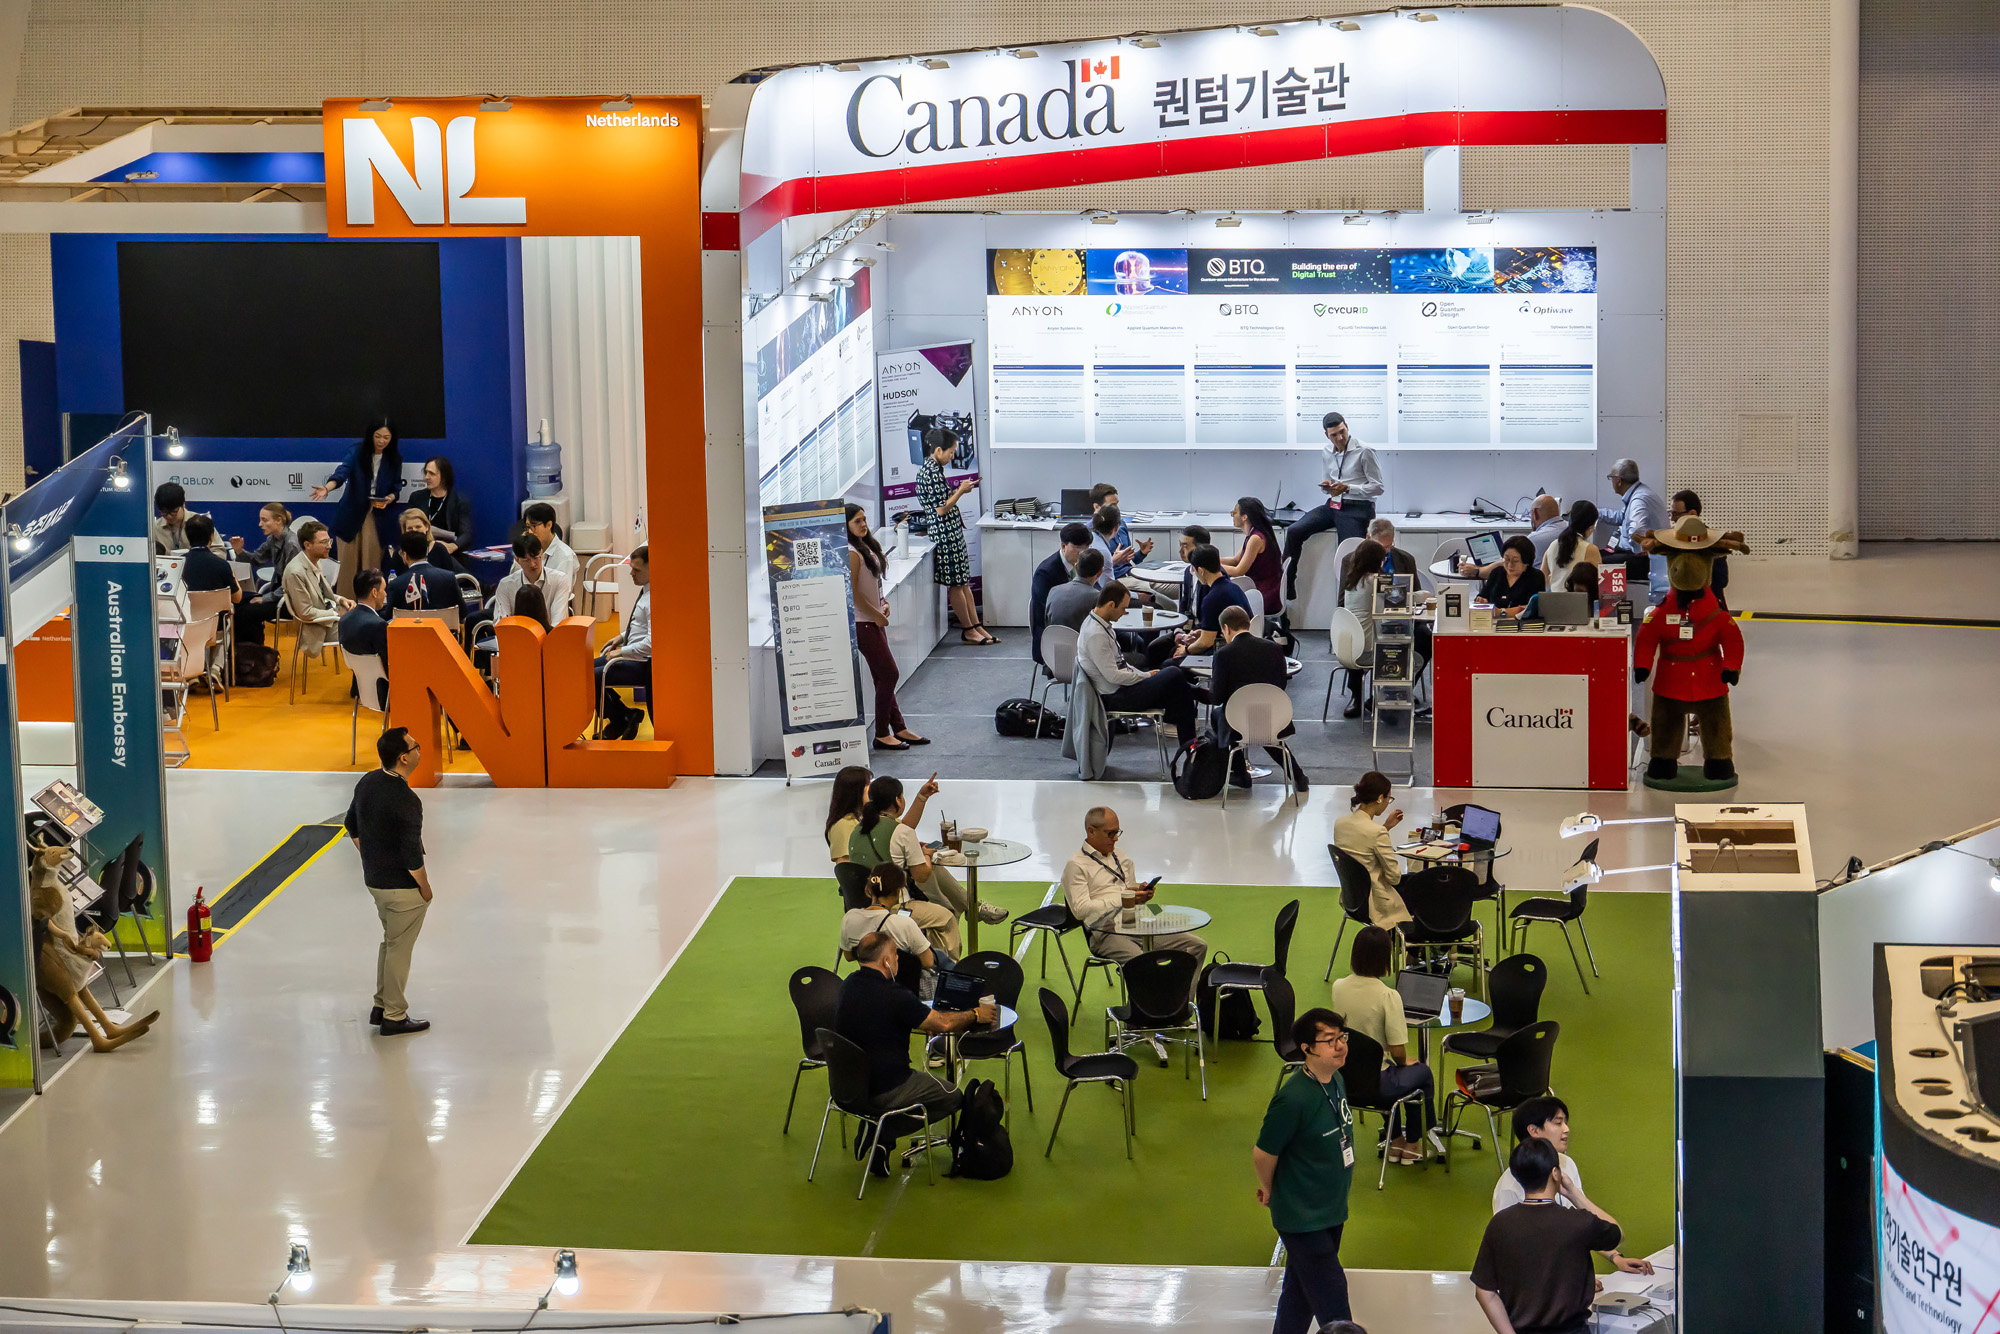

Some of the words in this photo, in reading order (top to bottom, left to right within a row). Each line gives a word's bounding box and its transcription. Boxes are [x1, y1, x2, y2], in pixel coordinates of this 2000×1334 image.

[1153, 62, 1349, 128] 퀀텀기술관
[847, 60, 1124, 157] Canada
[586, 112, 679, 127] Netherlands
[343, 116, 526, 224] NL
[1229, 259, 1265, 274] BTQ
[1292, 263, 1322, 271] Building
[1292, 271, 1316, 279] Digital
[1012, 306, 1063, 316] ANYON
[1234, 304, 1258, 314] BTQ
[1533, 306, 1573, 315] Optiwave
[882, 362, 920, 375] ANYON
[883, 389, 918, 400] HUDSON
[182, 477, 214, 486] QBLOX
[100, 544, 124, 555] B09
[108, 581, 126, 677] Australian
[387, 615, 676, 788] NL
[1486, 706, 1573, 729] Canada
[112, 683, 128, 767] Embassy
[815, 759, 840, 768] Canada
[1906, 1288, 1916, 1304] and
[1918, 1293, 1962, 1334] Technology
